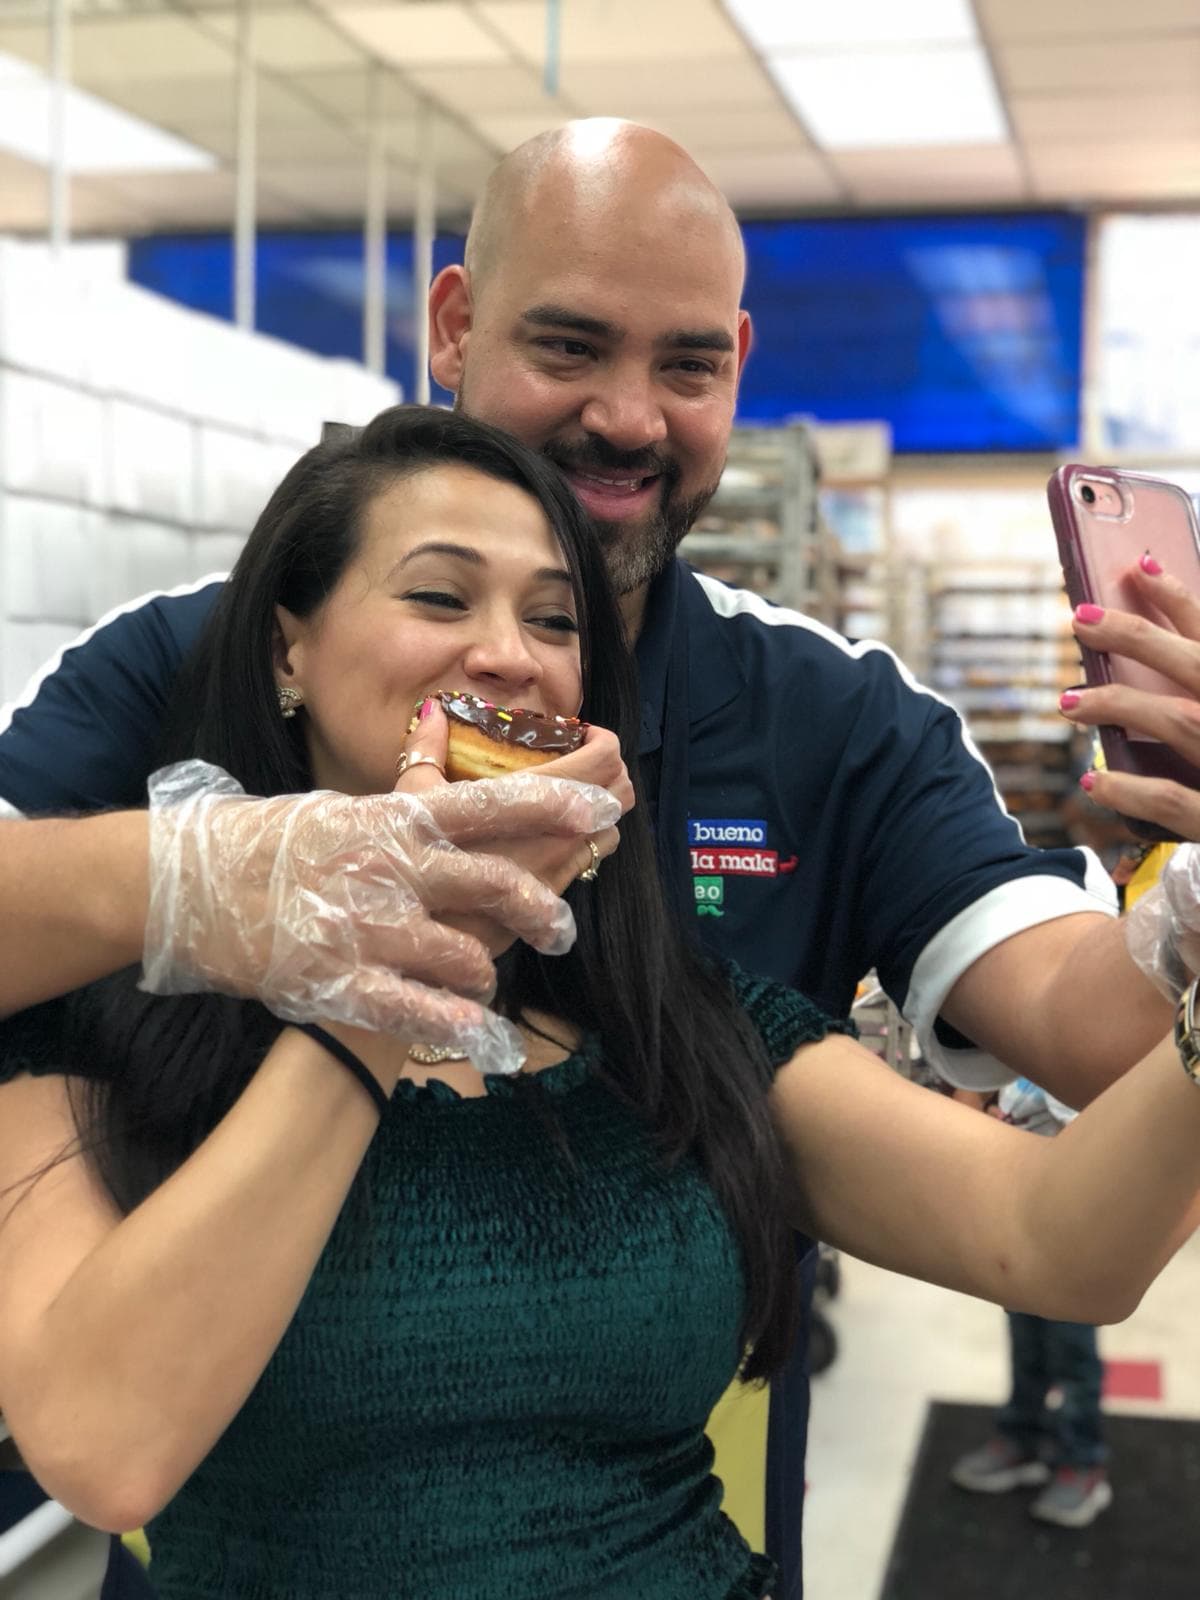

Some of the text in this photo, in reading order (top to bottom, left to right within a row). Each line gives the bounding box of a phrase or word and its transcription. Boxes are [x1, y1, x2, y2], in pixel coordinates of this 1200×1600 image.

[693, 822, 763, 842] bueno
[690, 851, 776, 873] la mala
